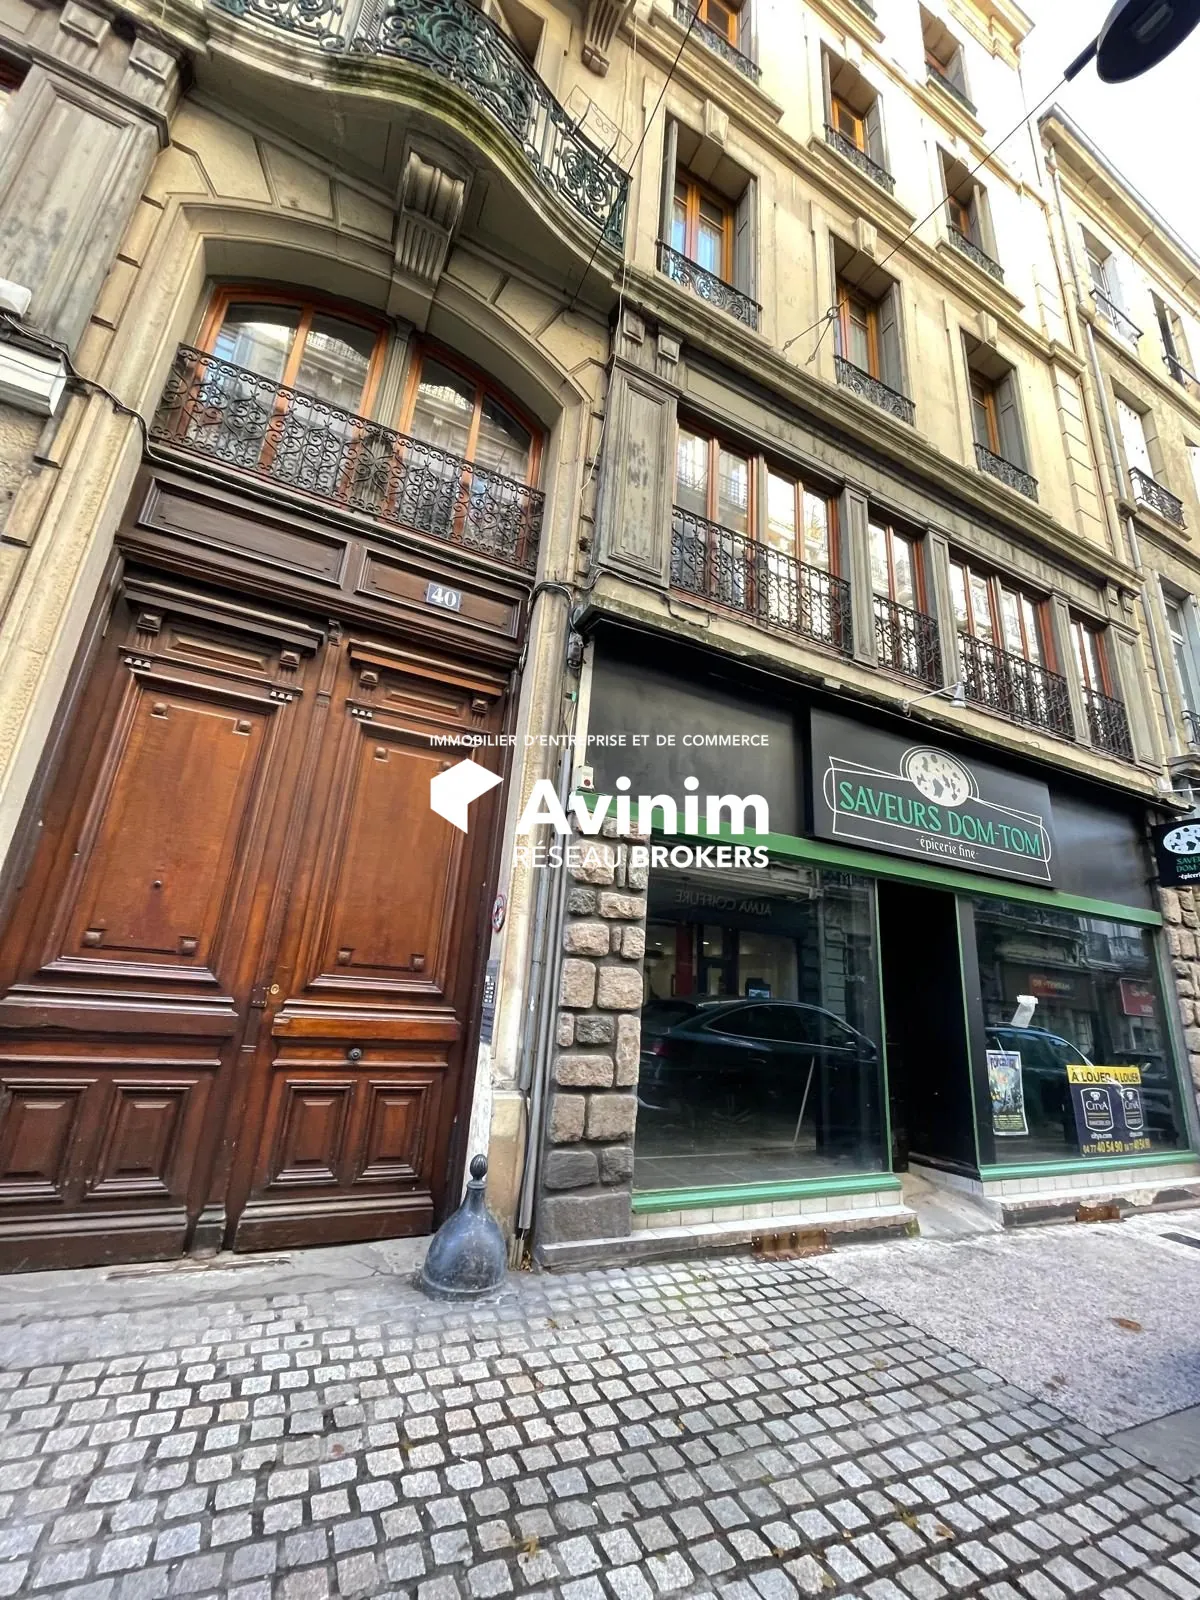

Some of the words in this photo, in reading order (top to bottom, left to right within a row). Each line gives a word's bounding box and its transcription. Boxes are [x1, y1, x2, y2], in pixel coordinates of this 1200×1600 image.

[431, 587, 457, 607] 40
[839, 781, 942, 832] SAVEURS
[948, 810, 1042, 857] DOM-TOM
[1081, 1071, 1111, 1083] LOUER
